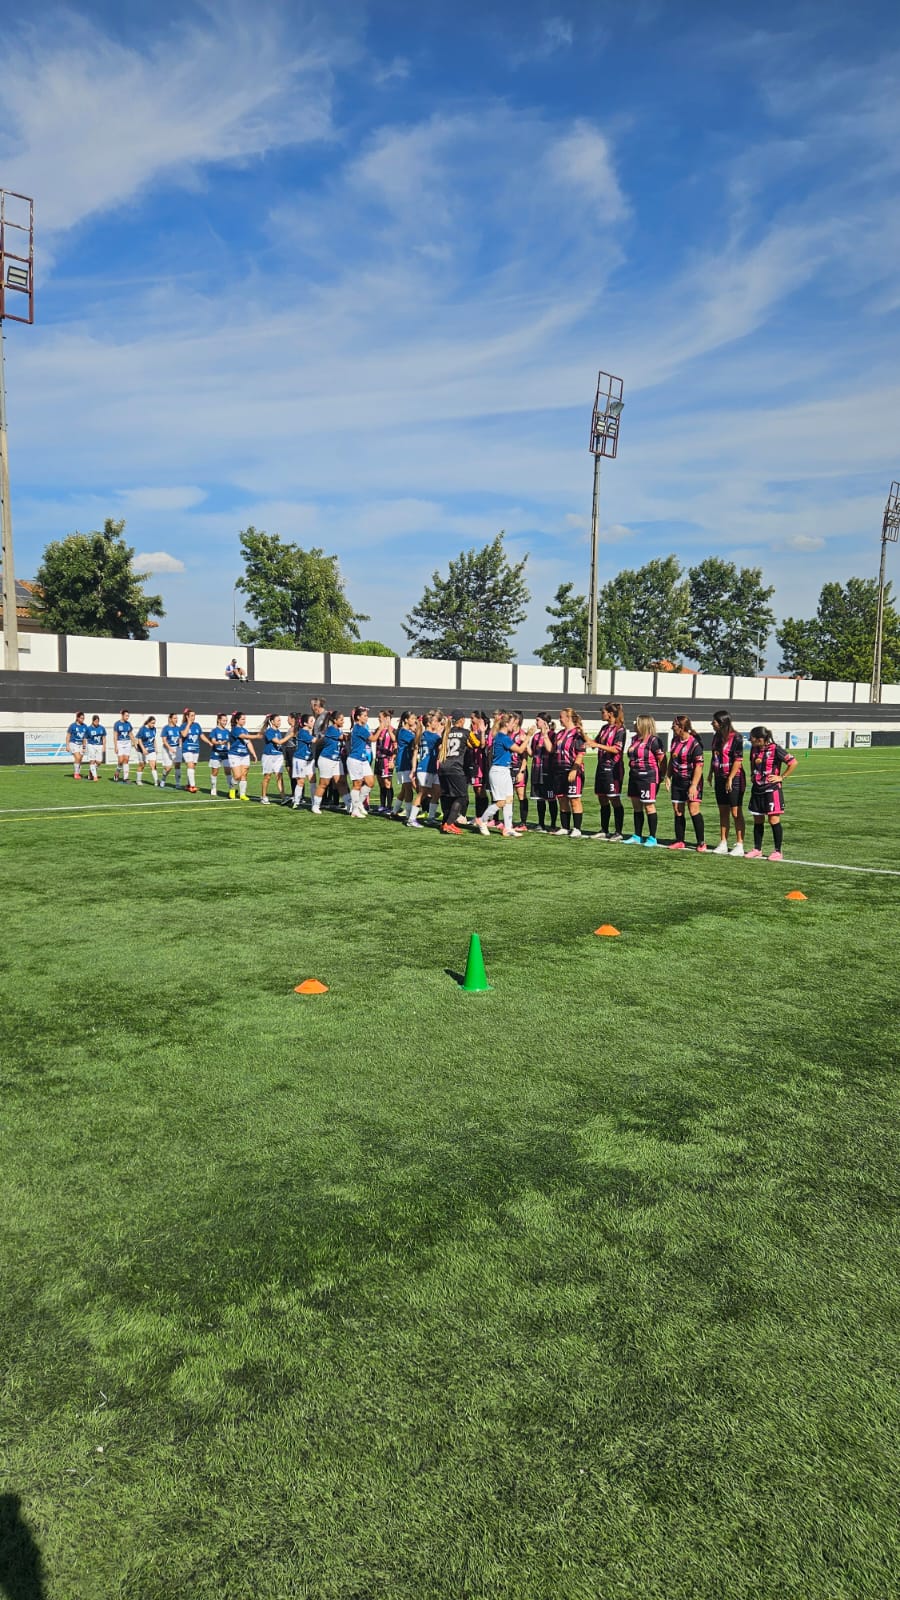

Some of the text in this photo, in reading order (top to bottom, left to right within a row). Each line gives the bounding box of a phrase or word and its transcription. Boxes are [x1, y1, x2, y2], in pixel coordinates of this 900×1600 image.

[567, 785, 577, 794] 23
[609, 783, 615, 792] 3
[640, 790, 650, 799] 24
[768, 802, 775, 812] 7
